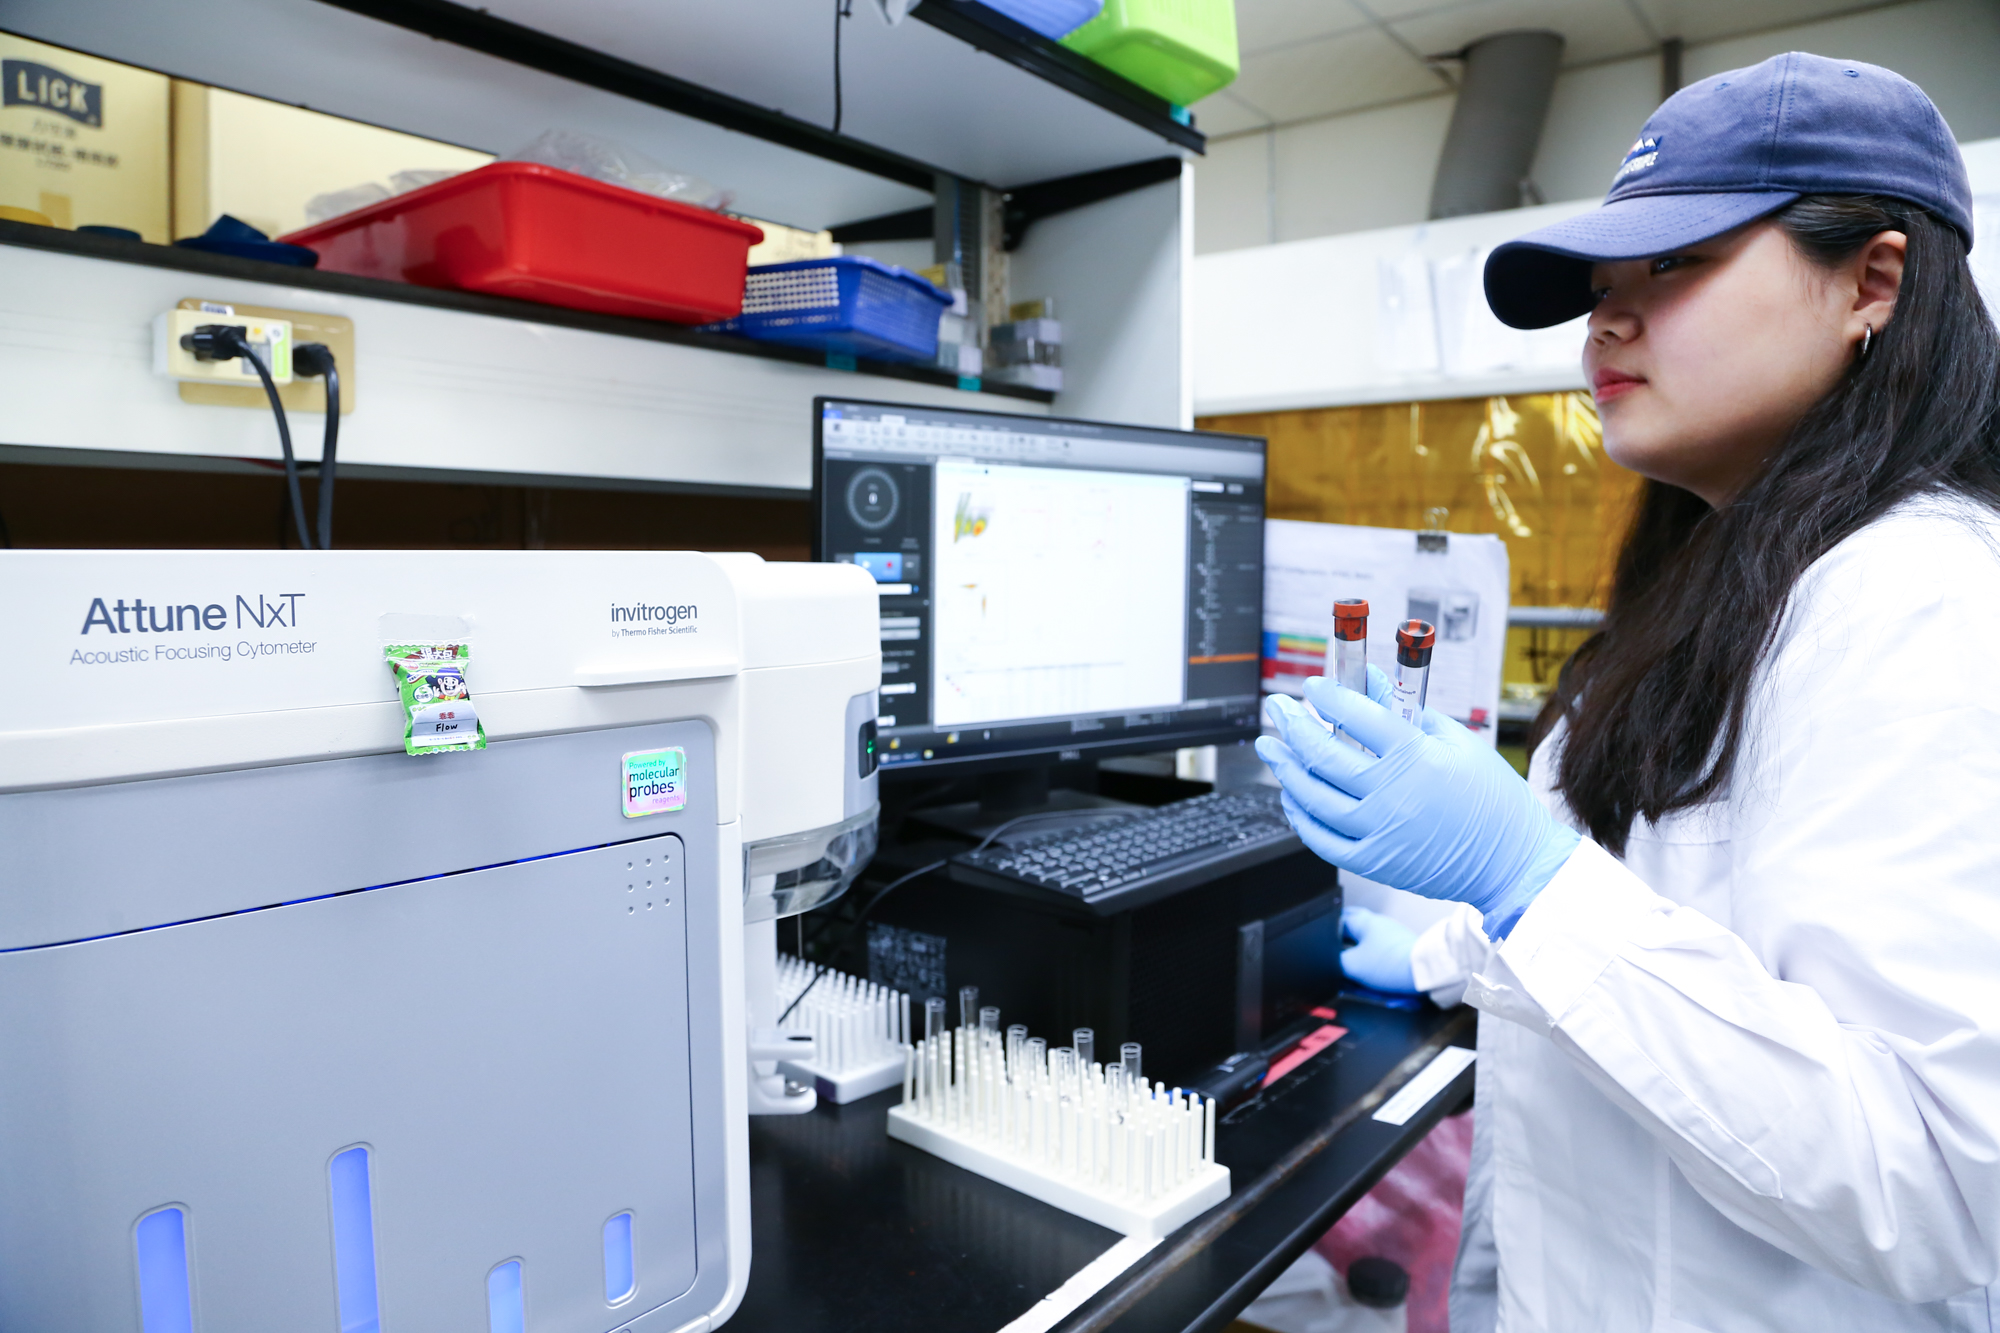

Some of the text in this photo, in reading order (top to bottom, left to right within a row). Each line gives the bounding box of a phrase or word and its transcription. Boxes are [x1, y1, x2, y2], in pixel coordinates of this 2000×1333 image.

[18, 69, 88, 114] LICK
[81, 593, 306, 635] Attune NxT
[611, 602, 698, 625] invitrogen
[611, 625, 698, 639] by Thermo Fisher Scientific
[69, 640, 317, 665] Acoustic Focusing Cytometer
[436, 723, 458, 732] Flow
[629, 759, 666, 769] Powered by
[629, 766, 680, 782] molecular
[629, 780, 675, 803] probes
[652, 795, 680, 804] reagents
